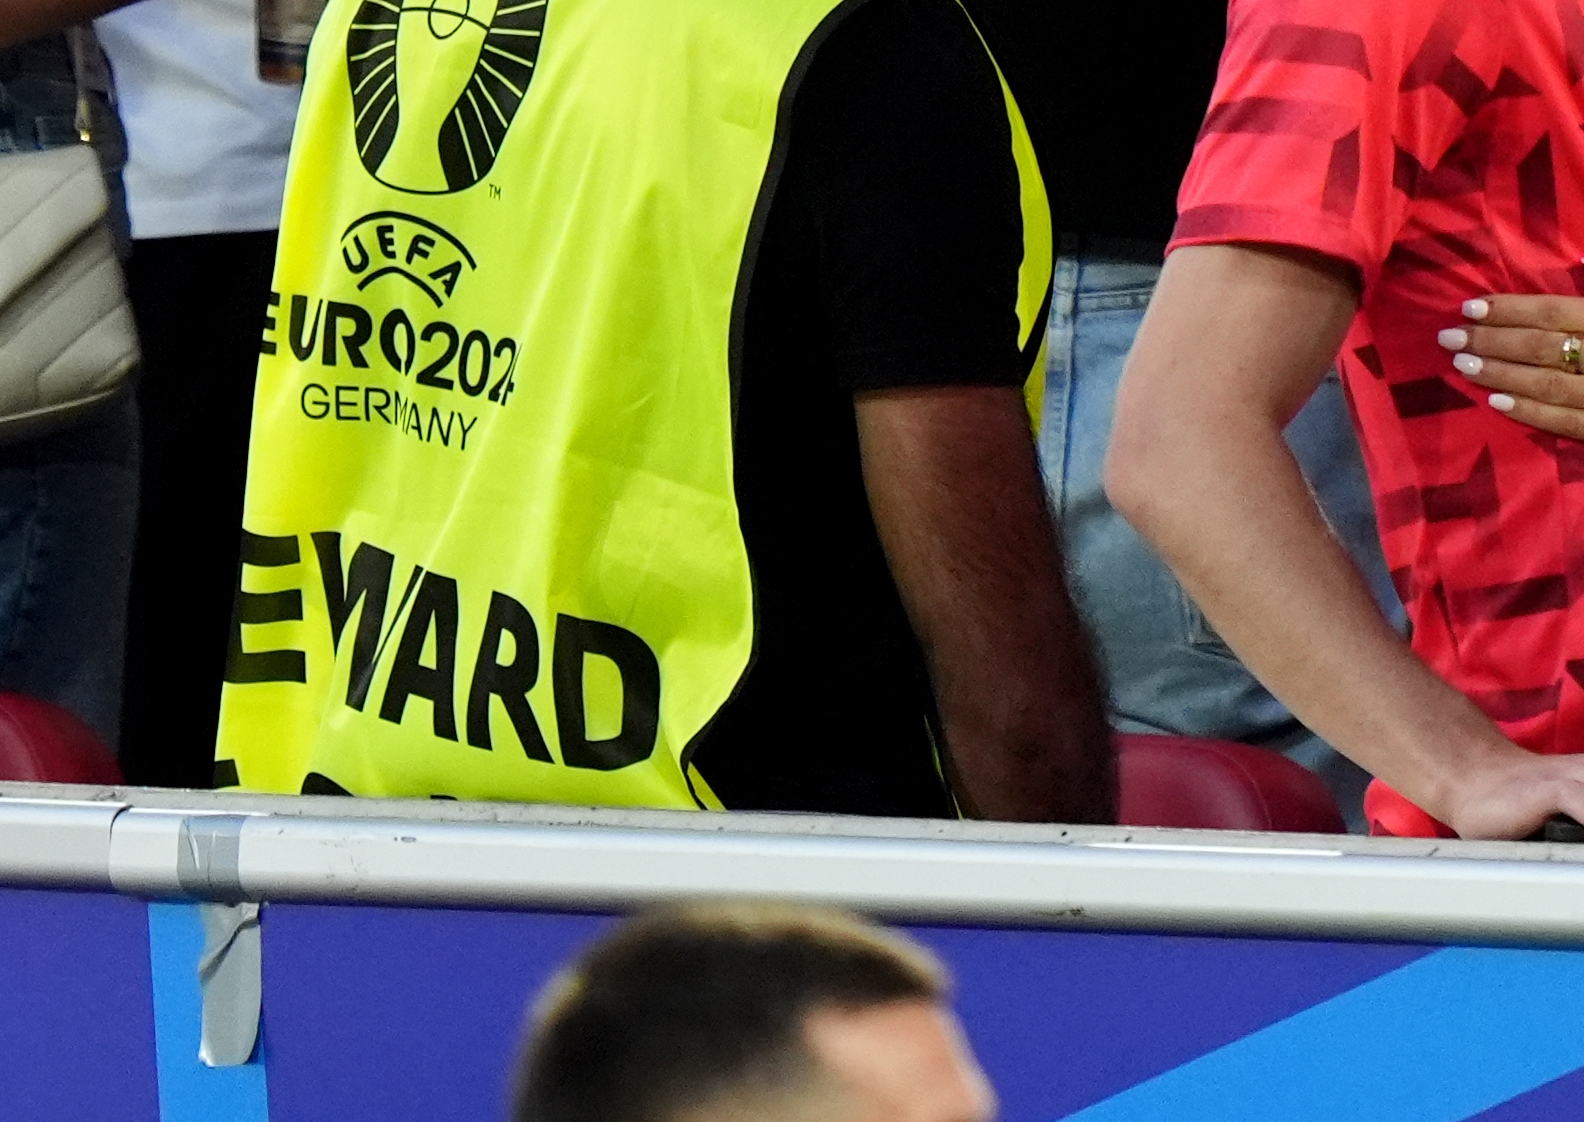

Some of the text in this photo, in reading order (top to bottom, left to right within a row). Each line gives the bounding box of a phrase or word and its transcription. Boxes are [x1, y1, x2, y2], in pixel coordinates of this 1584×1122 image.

[342, 224, 462, 298] UEFA
[301, 383, 478, 451] GERMANY
[223, 528, 661, 772] EWARD
